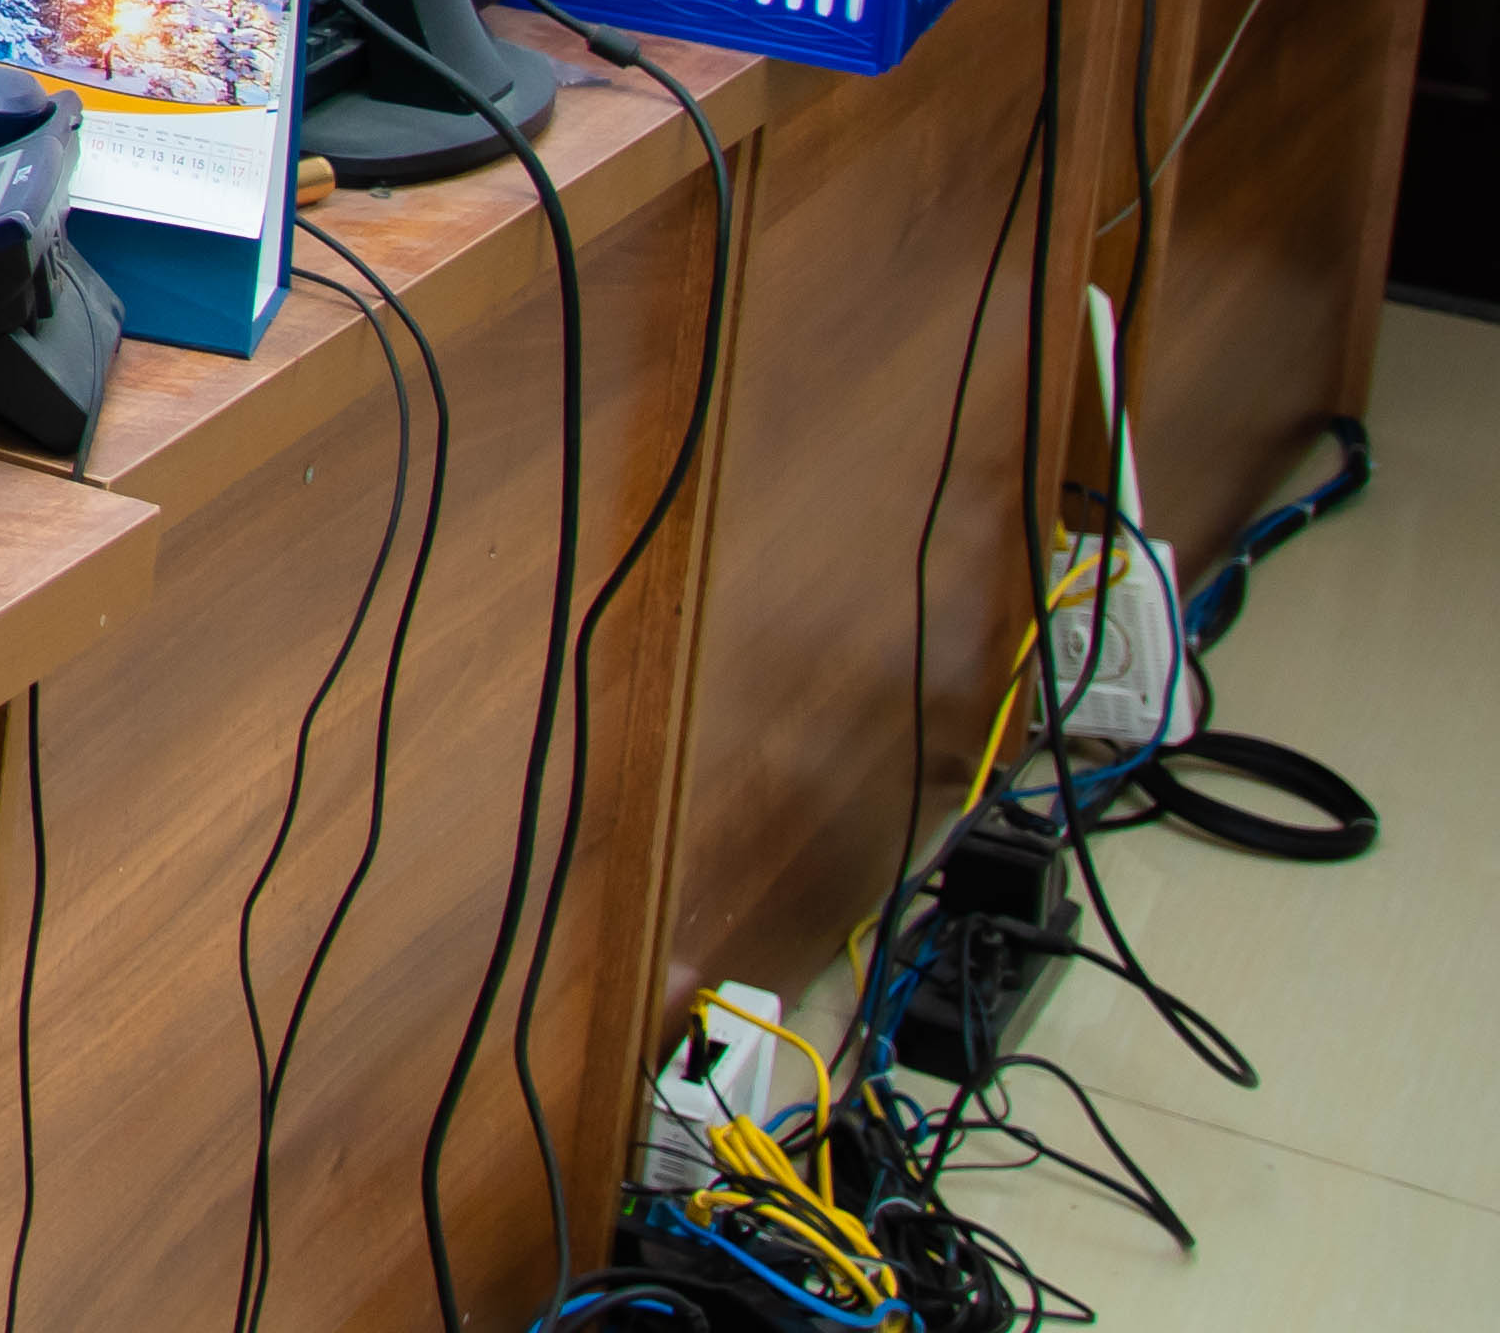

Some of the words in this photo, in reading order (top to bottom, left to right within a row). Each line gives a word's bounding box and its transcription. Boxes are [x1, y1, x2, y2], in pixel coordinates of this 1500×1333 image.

[92, 138, 104, 150] 10
[112, 142, 123, 155] 11
[132, 146, 145, 159] 12
[152, 149, 164, 162] 13
[172, 153, 184, 166] 14
[192, 157, 205, 171] 15
[212, 161, 225, 174] 16
[232, 165, 245, 178] 17
